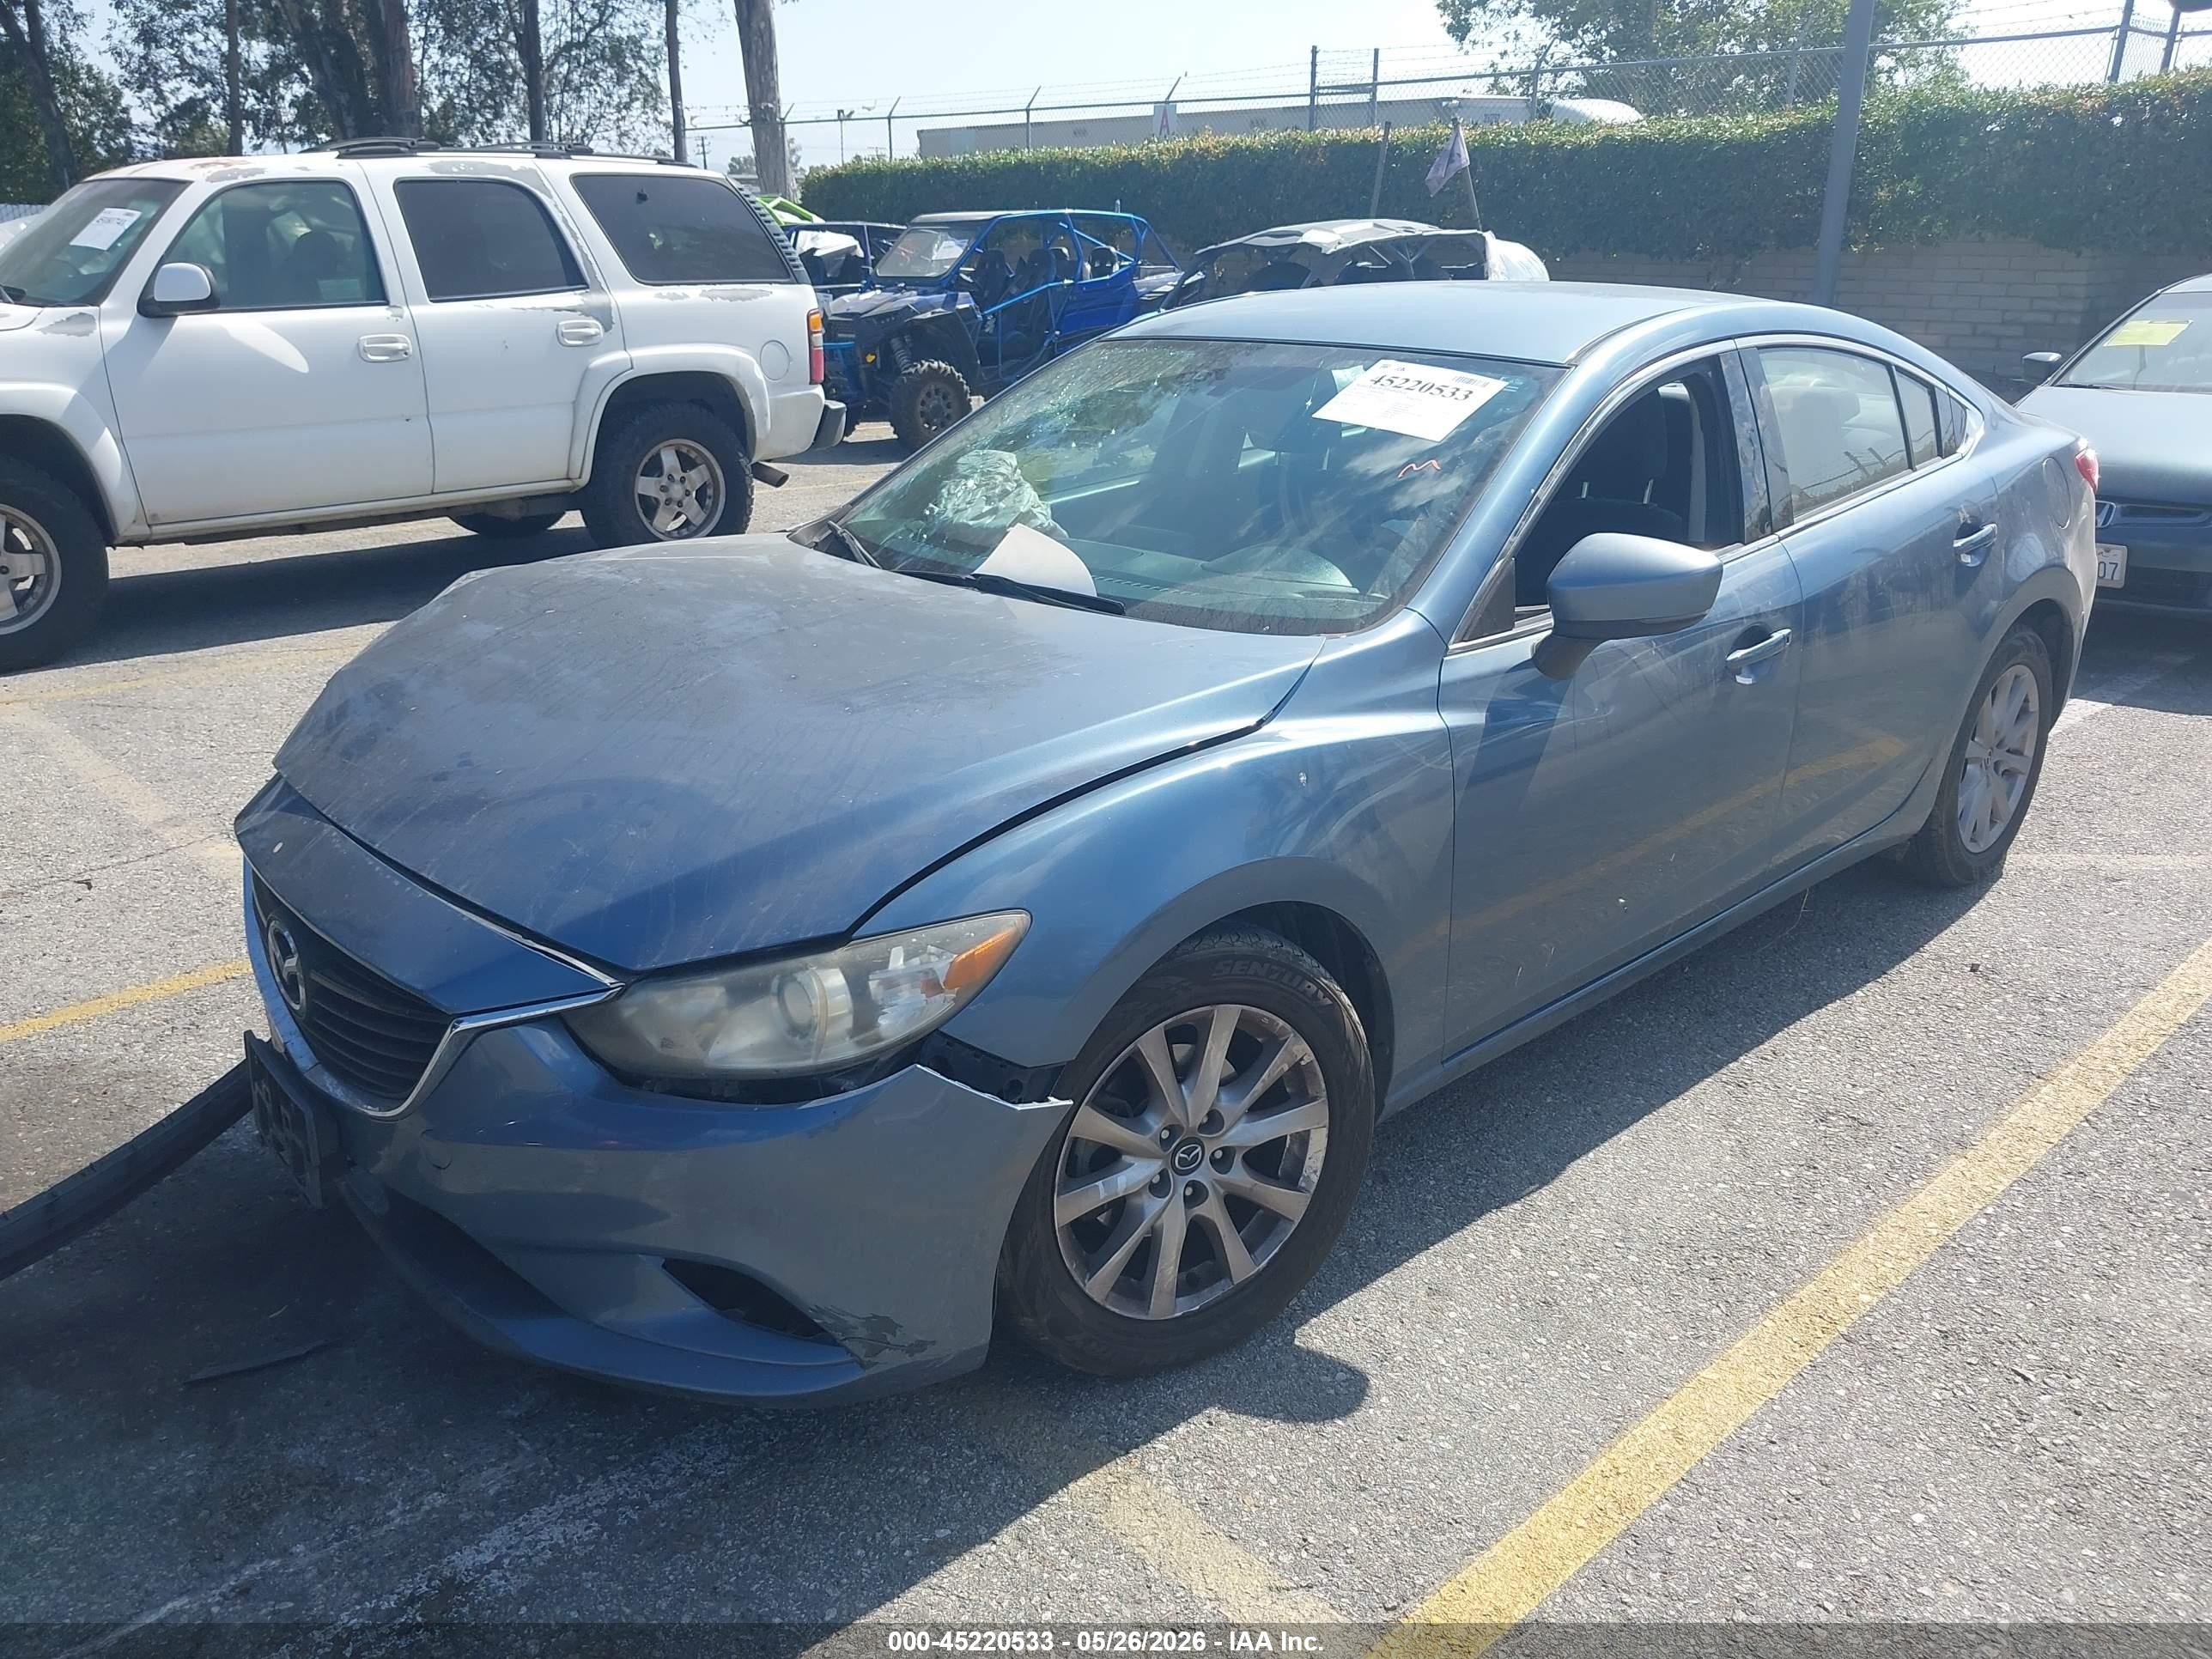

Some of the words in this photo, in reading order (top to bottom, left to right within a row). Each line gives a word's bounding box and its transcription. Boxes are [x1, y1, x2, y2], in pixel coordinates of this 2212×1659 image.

[1159, 106, 1170, 136] A
[1370, 374, 1474, 401] 45220533
[1213, 960, 1334, 1006] SENTURY
